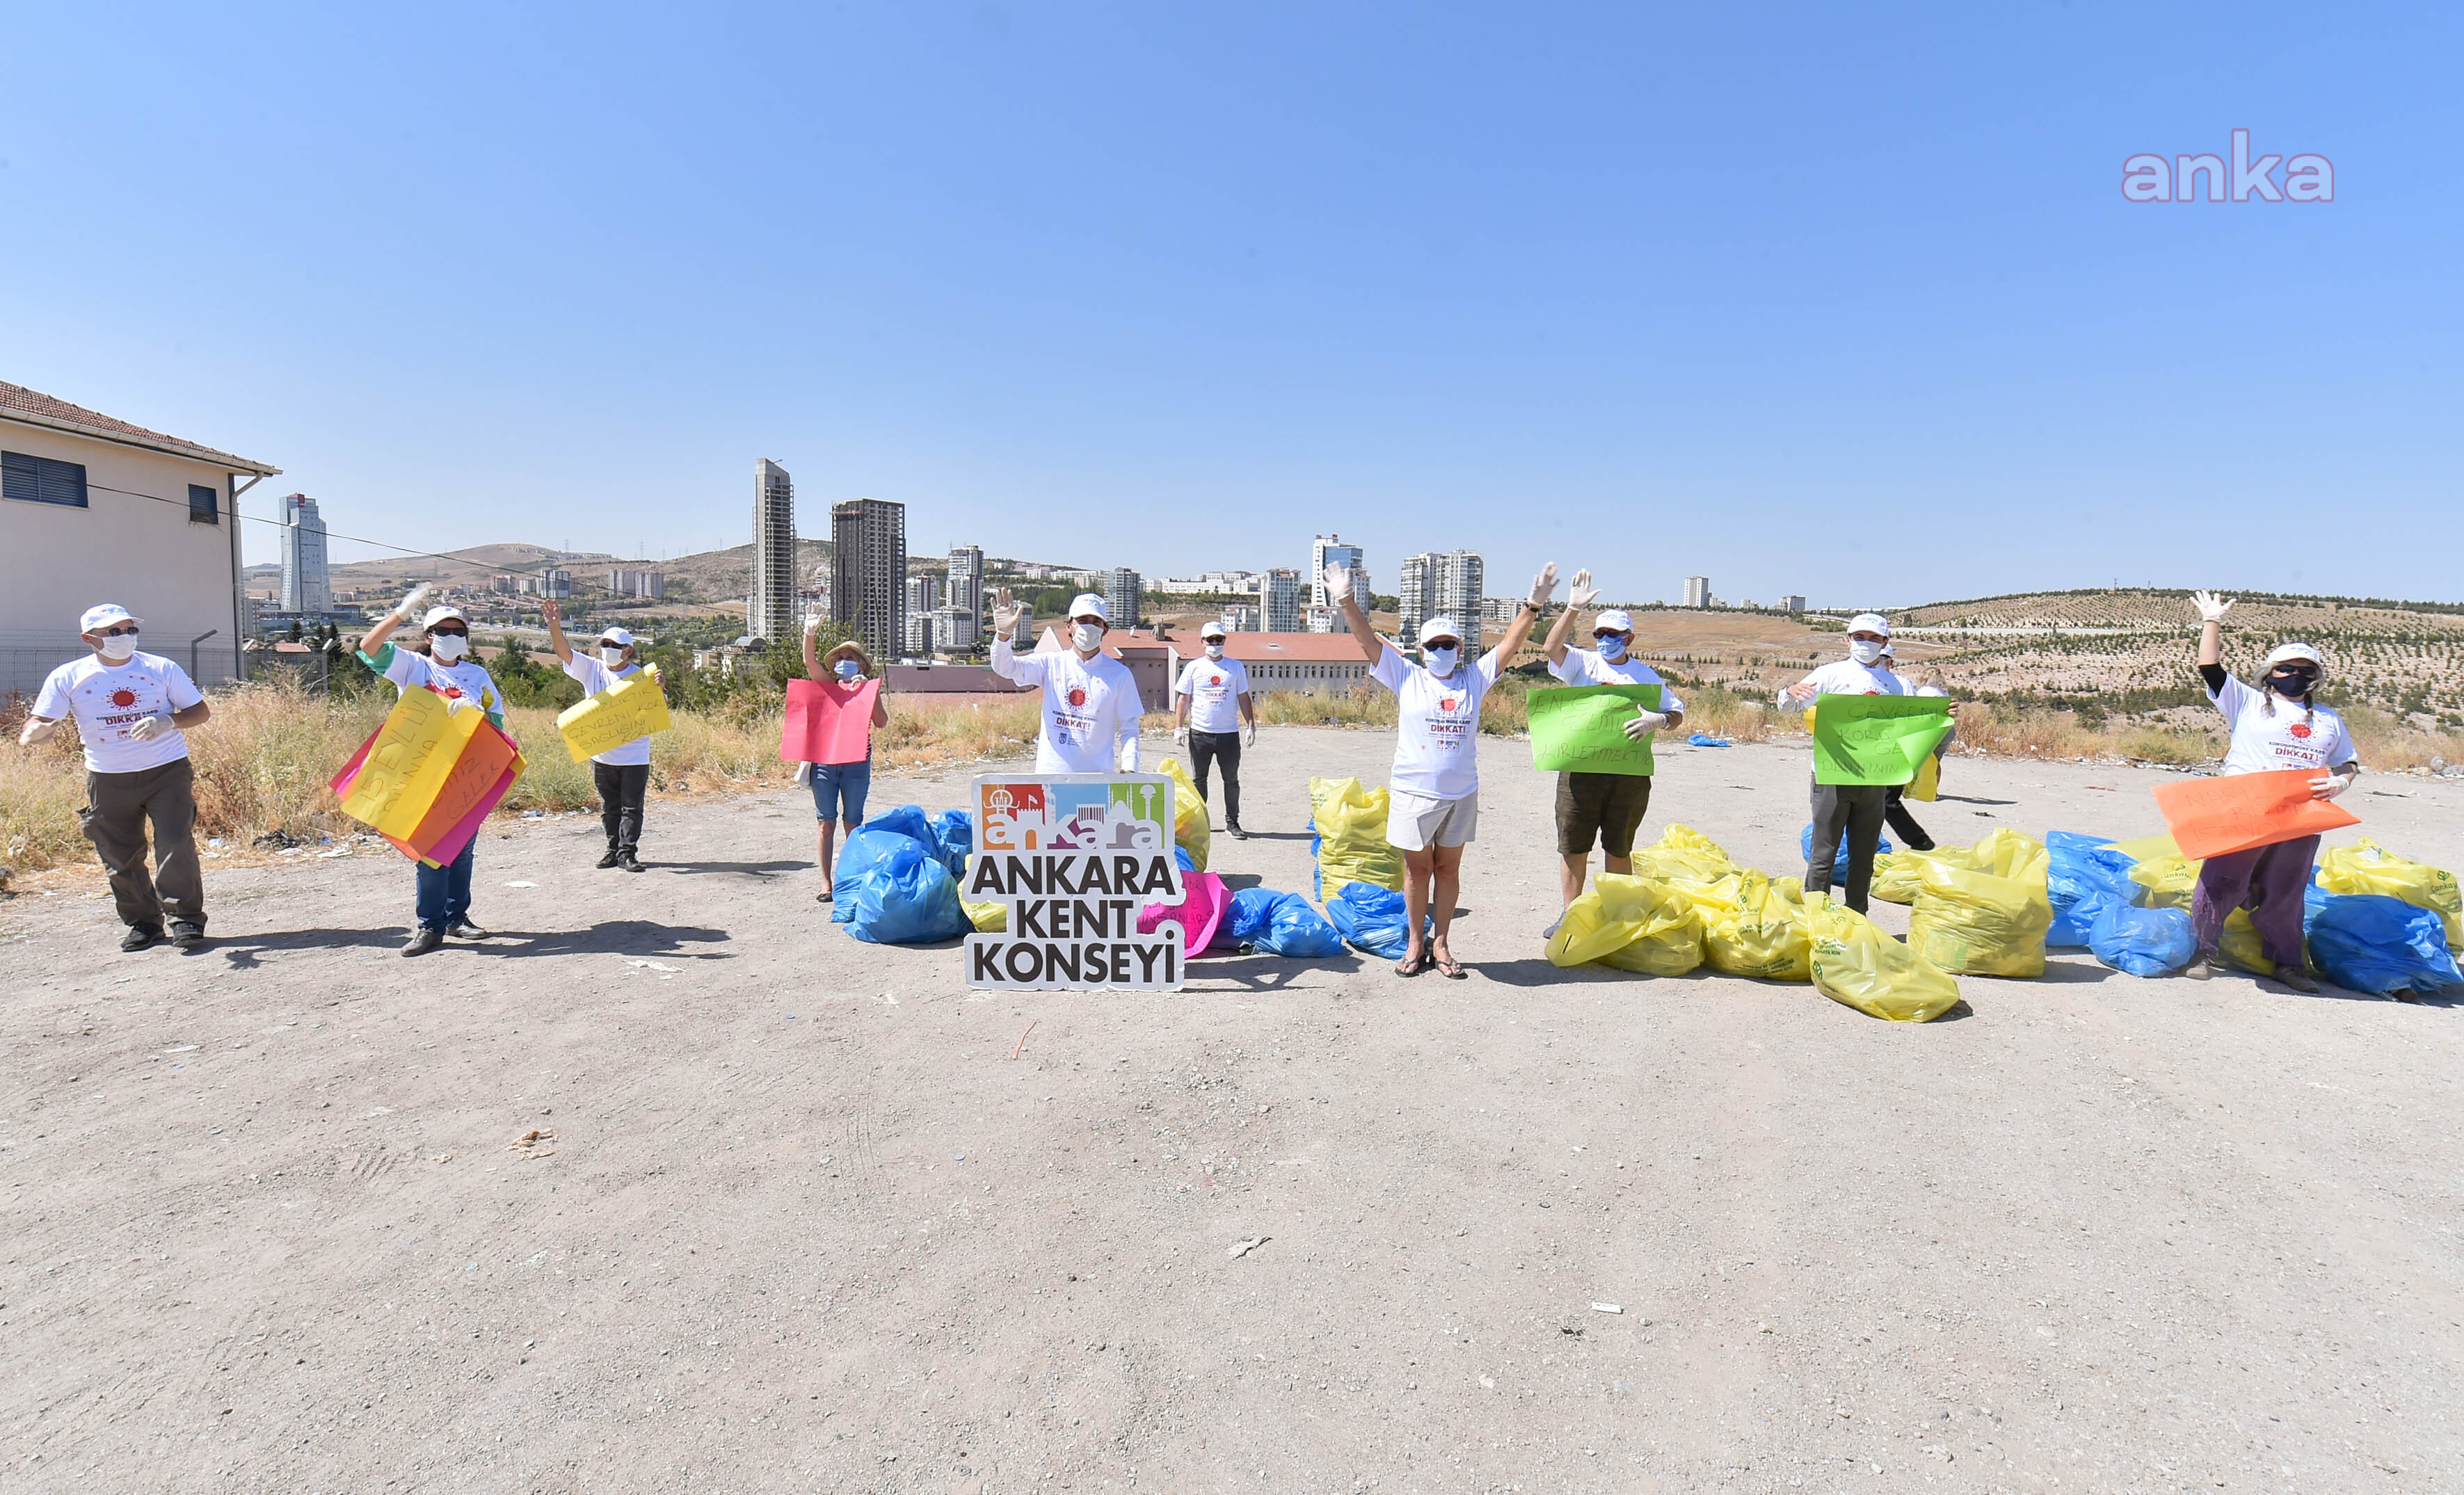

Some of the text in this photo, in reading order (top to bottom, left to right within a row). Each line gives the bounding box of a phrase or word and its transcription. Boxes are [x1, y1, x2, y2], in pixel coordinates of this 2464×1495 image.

[1572, 691, 1647, 711] GÜZE
[2275, 747, 2319, 761] DİKKAT!
[983, 801, 1164, 849] ankara
[970, 856, 1176, 895] ANKARA
[1016, 900, 1134, 938] KENT
[974, 929, 1175, 983] KONSEYİ
